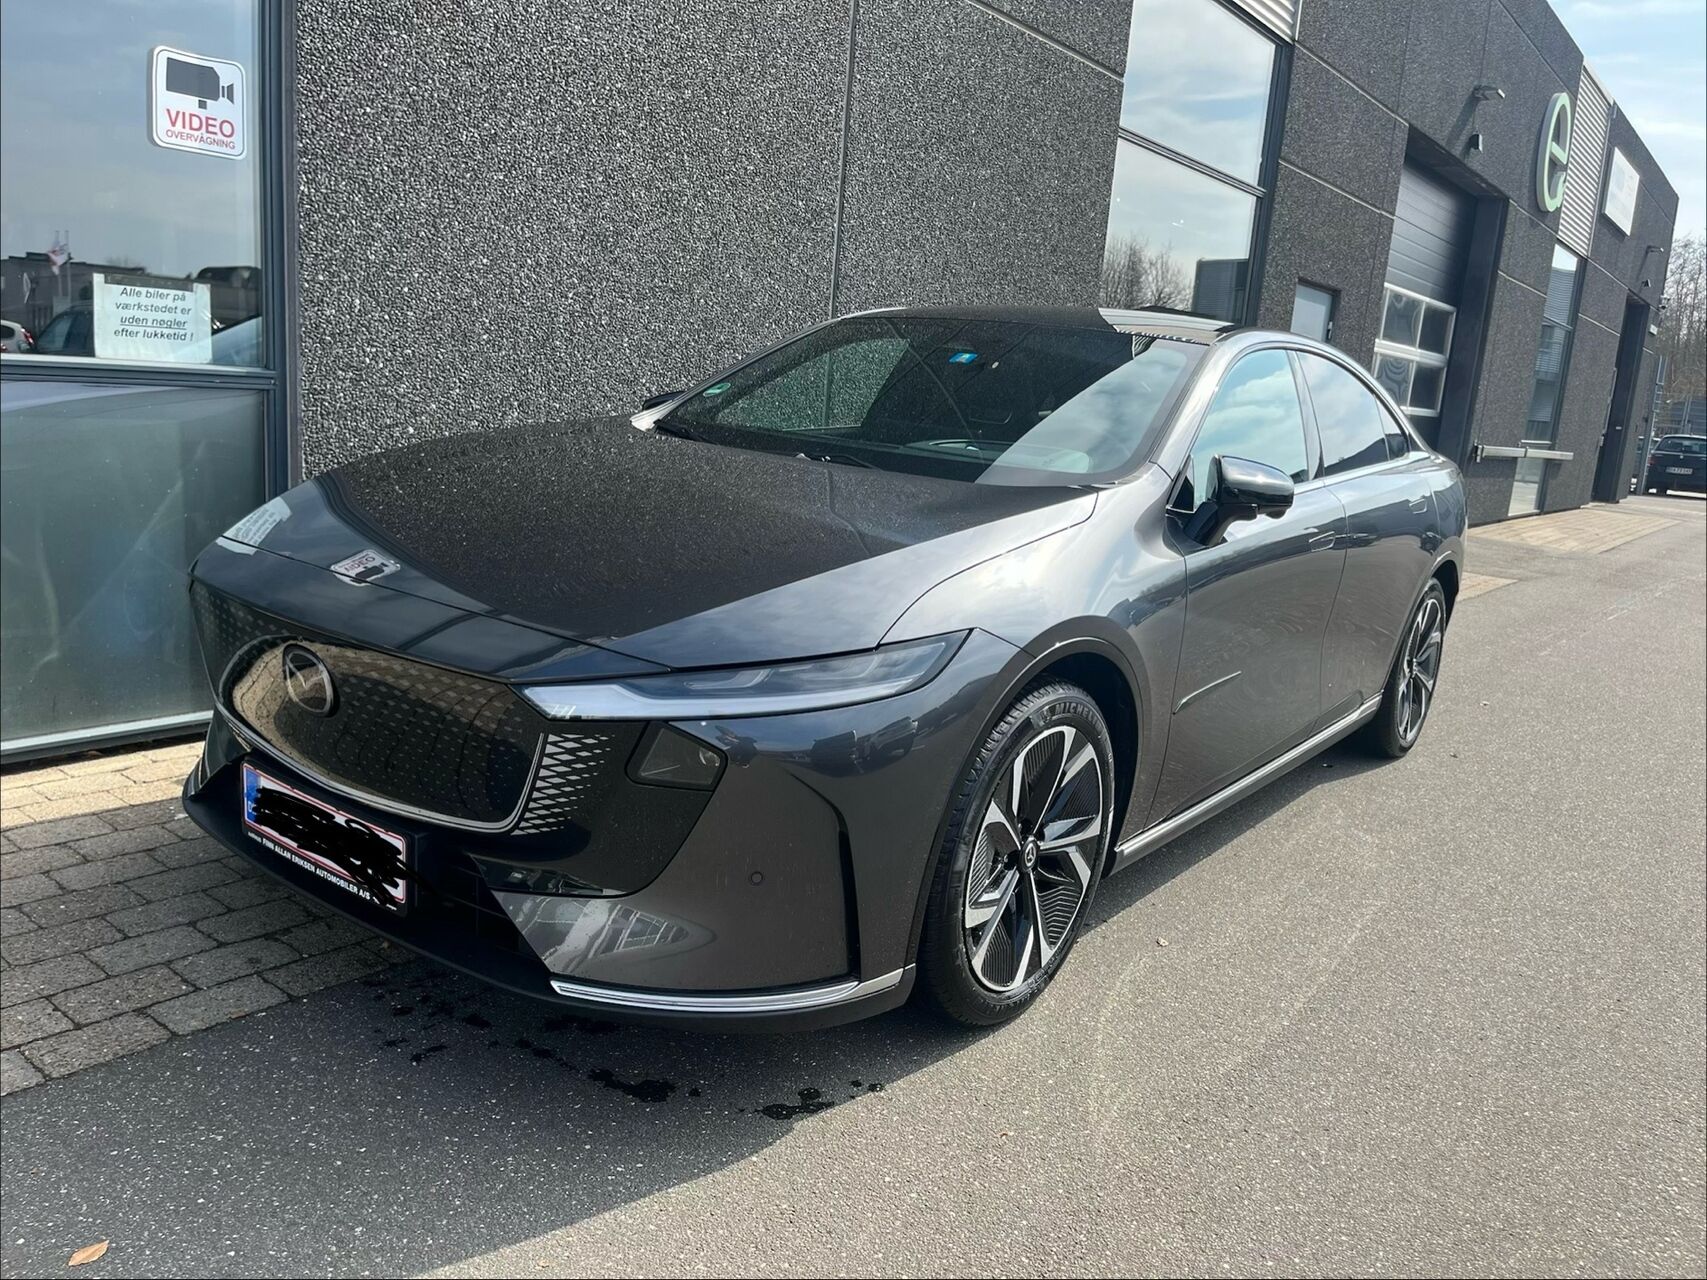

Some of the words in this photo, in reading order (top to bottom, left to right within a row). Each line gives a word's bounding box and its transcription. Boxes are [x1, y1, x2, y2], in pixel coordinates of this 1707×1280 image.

[166, 108, 235, 138] VIDEO
[165, 129, 236, 150] OVERVÅGNING
[120, 287, 142, 297] Alle
[145, 289, 170, 300] biler
[172, 292, 186, 303] på
[115, 302, 178, 314] værkstedet
[181, 307, 192, 315] er
[120, 315, 148, 326] uden
[151, 318, 188, 329] nøgler
[114, 327, 140, 339] efter
[143, 329, 187, 341] lukketid
[316, 867, 359, 895] AUTOMOBILER
[359, 888, 371, 900] A/S
